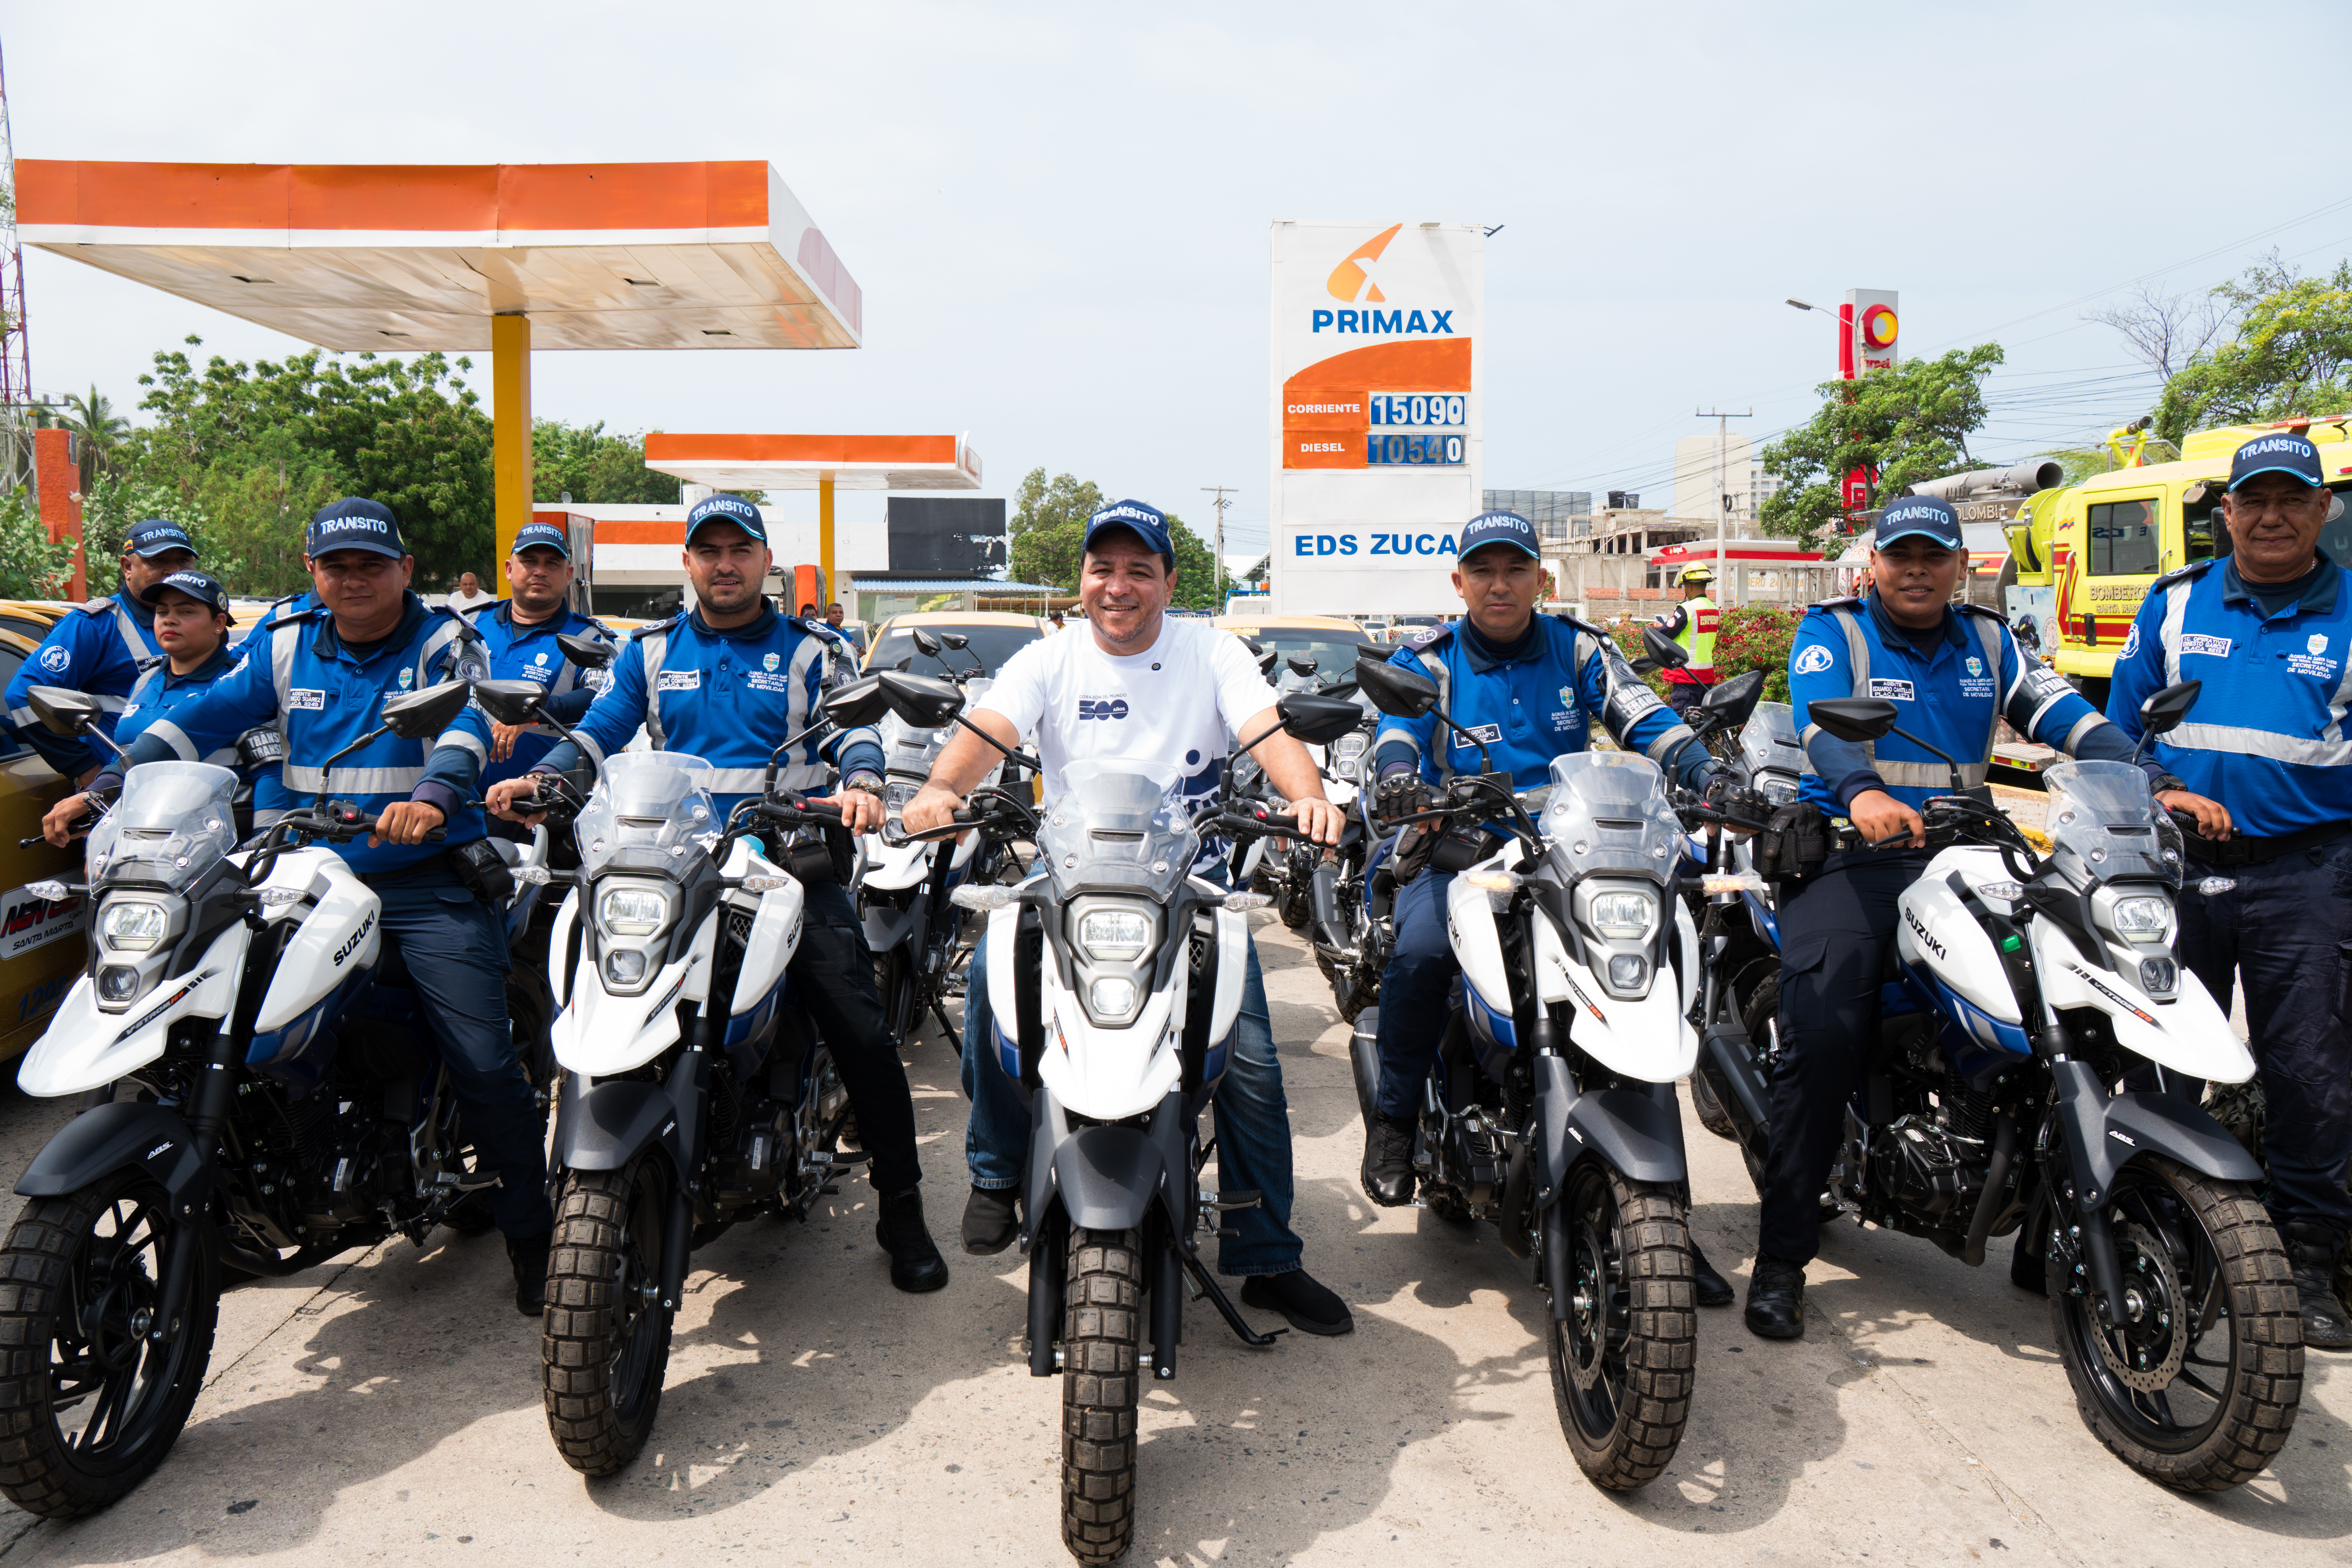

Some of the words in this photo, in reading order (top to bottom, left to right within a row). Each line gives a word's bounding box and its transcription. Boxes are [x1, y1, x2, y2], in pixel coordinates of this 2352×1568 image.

[1312, 310, 1453, 334] PRIMAX
[1287, 403, 1360, 414] CORRIENTE
[1374, 396, 1463, 425] 15090
[1301, 443, 1345, 452] DIESEL
[1372, 436, 1462, 463] 10540
[2239, 439, 2311, 460] TRANSITO
[692, 500, 753, 520] TRANSITO
[1093, 506, 1159, 526] TRANSITO
[1886, 506, 1950, 526] TRANSITO
[321, 517, 387, 534] TRANSITO
[522, 526, 563, 541] TRANSITO
[1468, 515, 1528, 534] TRANSITO
[141, 528, 187, 542] TRANSITO
[1296, 534, 1358, 556] EDS
[1370, 534, 1458, 555] ZUCA
[2096, 604, 2120, 613] SANTA
[2122, 603, 2143, 613] MART
[2193, 637, 2226, 645] OPERATIVO
[2292, 662, 2329, 673] SECRETARIA
[2297, 668, 2331, 679] MOVILIDAD
[751, 678, 783, 687] SECRETARIA
[1079, 699, 1129, 721] 500
[0, 898, 49, 938] NGN
[13, 933, 42, 950] SANTA
[44, 921, 73, 938] MARTA
[334, 909, 375, 967] SUZUKI
[1905, 907, 1946, 961] SUZUKI
[662, 1120, 675, 1136] ABS
[1568, 1127, 1583, 1143] ABS
[2109, 1131, 2134, 1144] ABS
[147, 1141, 170, 1160] ABS
